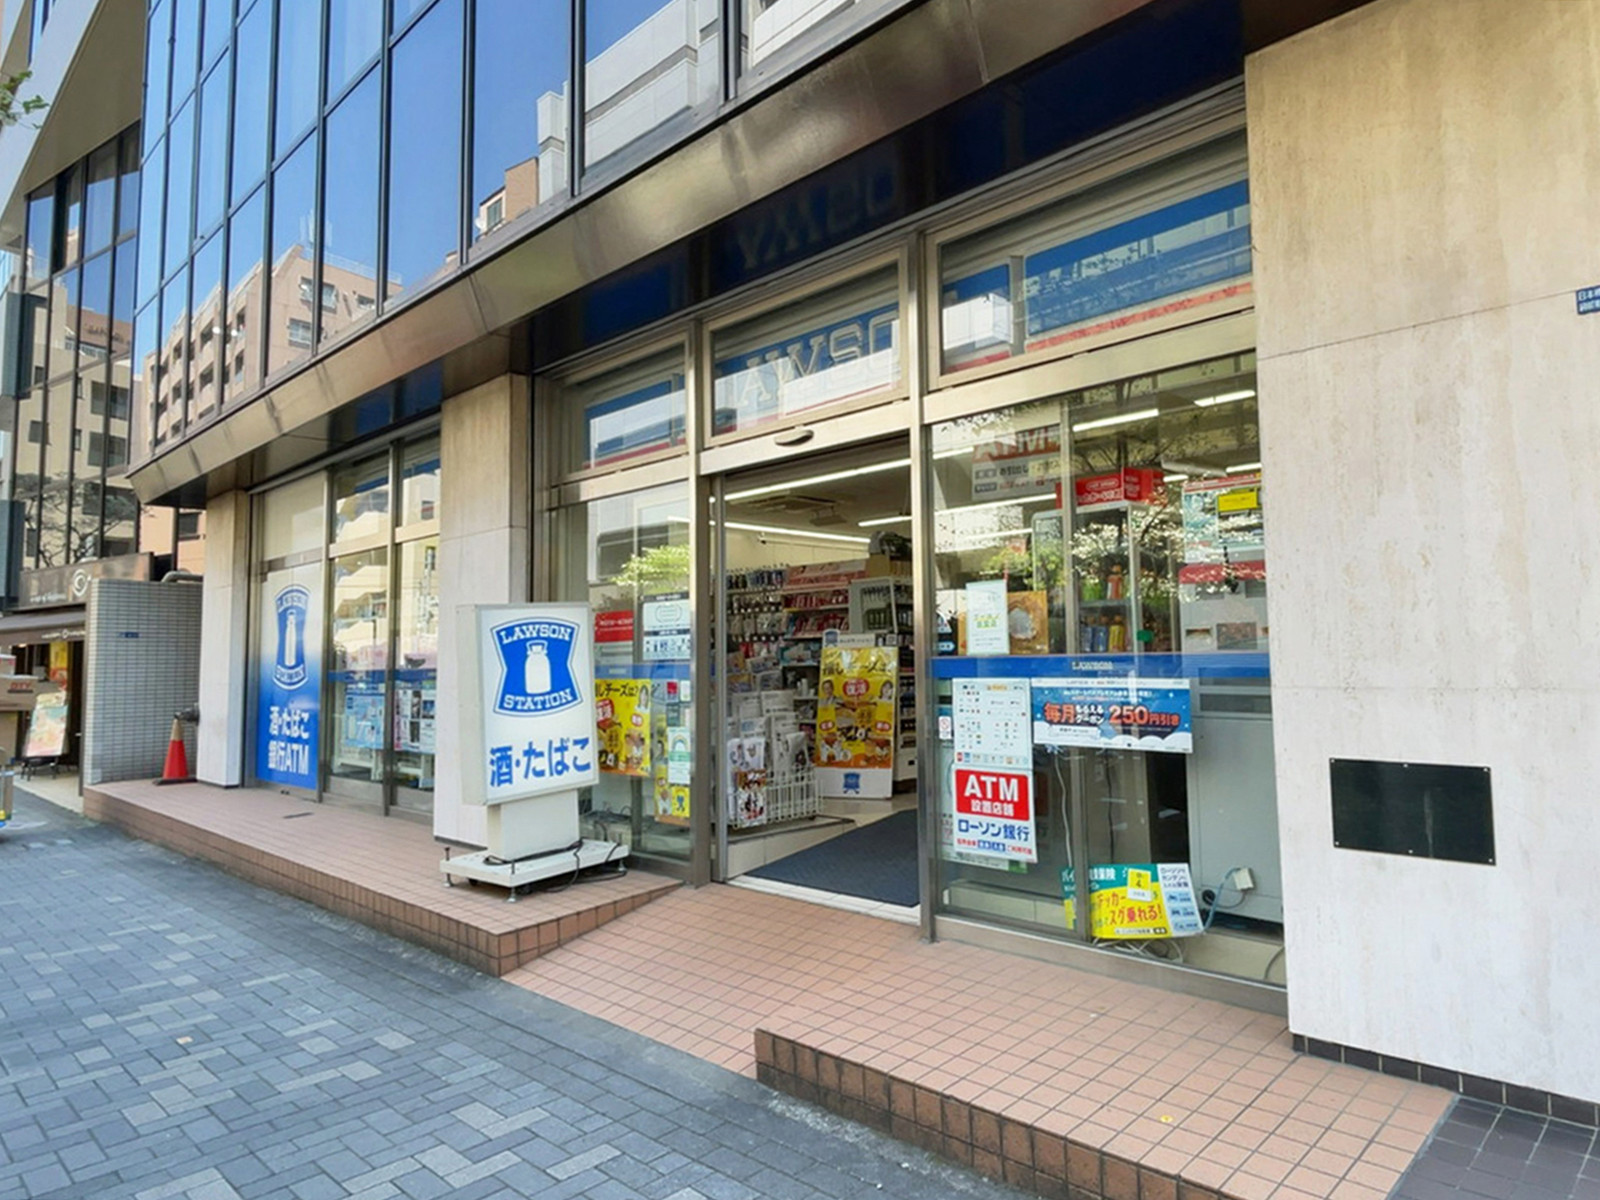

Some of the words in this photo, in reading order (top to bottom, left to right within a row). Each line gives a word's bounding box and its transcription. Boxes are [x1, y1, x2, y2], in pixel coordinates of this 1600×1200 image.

[500, 624, 572, 645] LAWSON
[503, 688, 573, 711] STATION
[490, 737, 592, 787] 酒・たばこ
[964, 774, 1019, 802] ATM
[958, 819, 1030, 841] ローソン銀行
